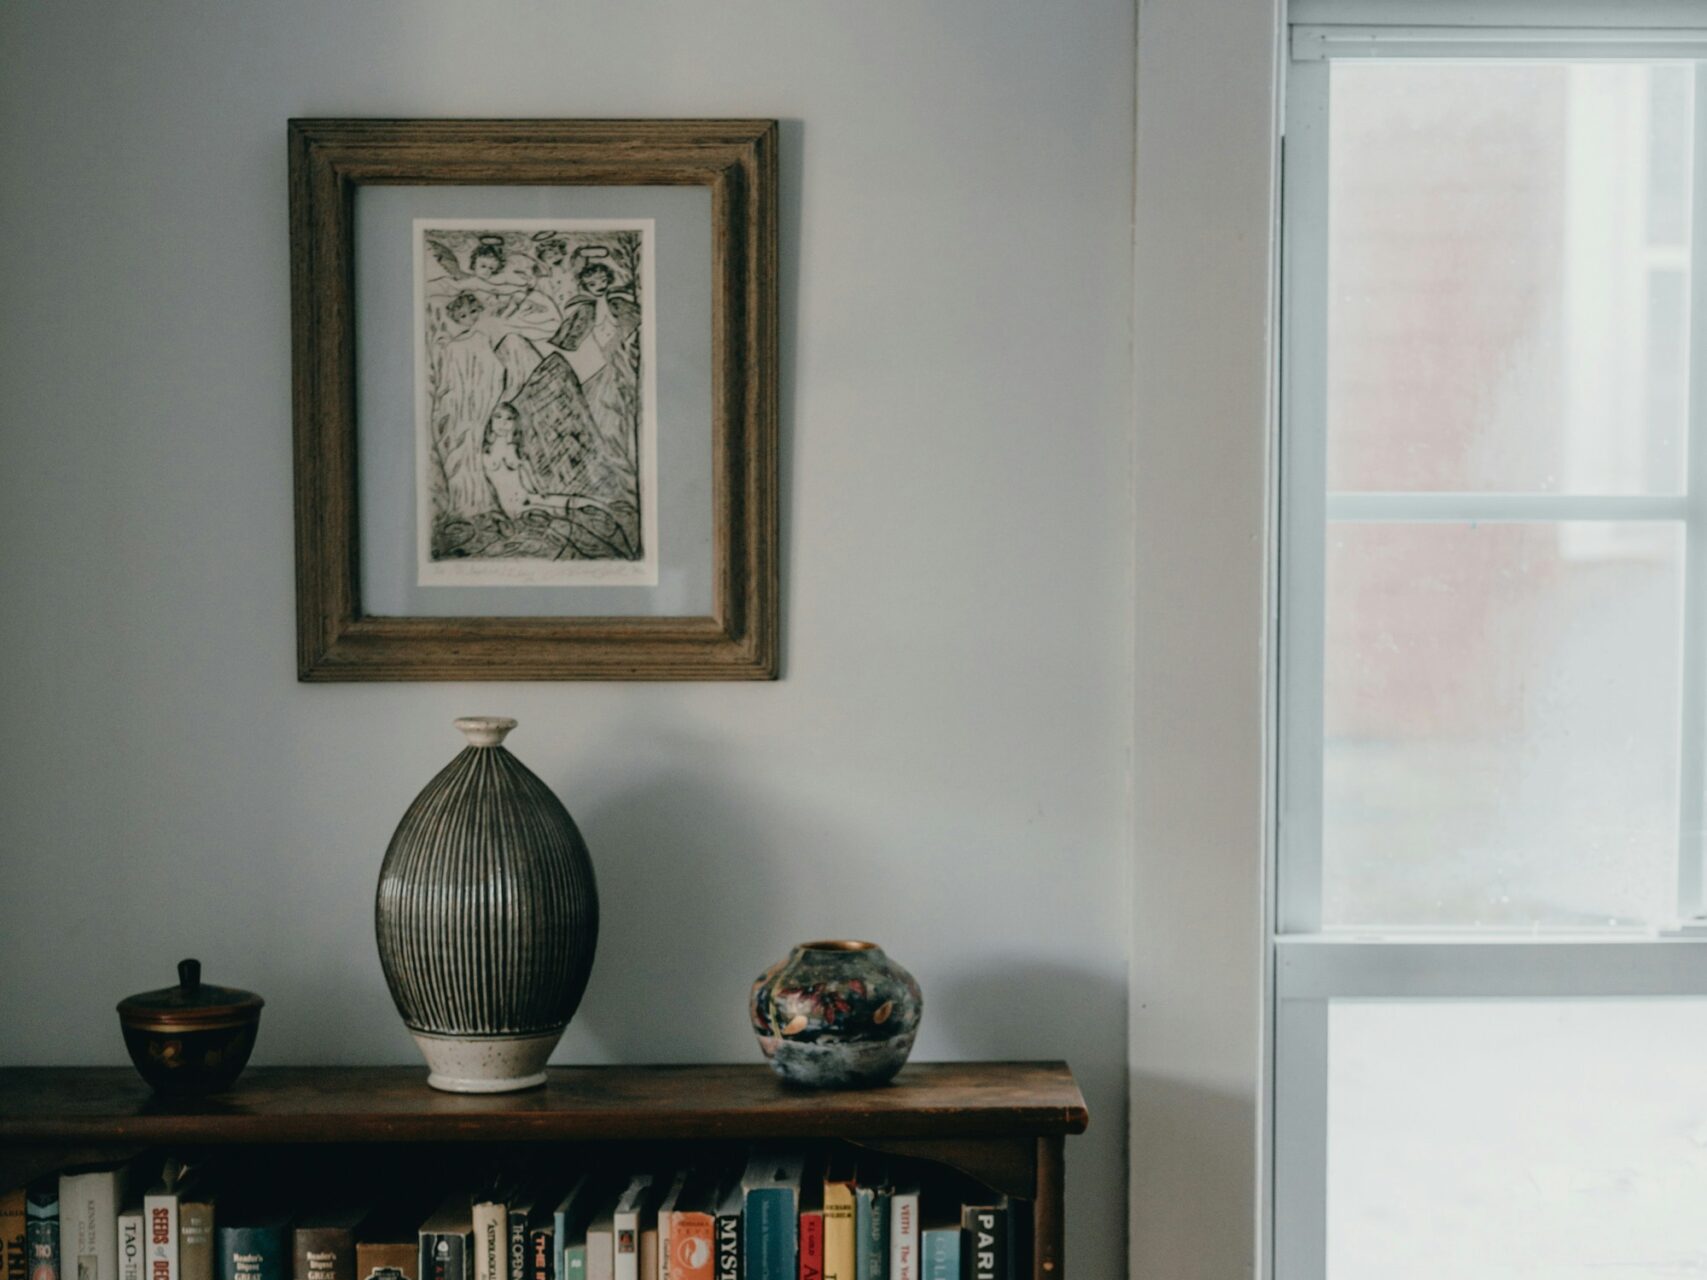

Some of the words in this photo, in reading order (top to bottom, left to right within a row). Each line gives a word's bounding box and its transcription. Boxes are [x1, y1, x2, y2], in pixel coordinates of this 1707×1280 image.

[154, 1207, 169, 1245] SEEDS
[512, 1224, 524, 1244] THE
[306, 1252, 337, 1261] Reader's
[536, 1235, 545, 1268] THE
[901, 1246, 911, 1264] The
[233, 1252, 264, 1262] Reader's
[236, 1263, 260, 1271] Digest
[310, 1261, 333, 1270] Digest
[308, 1271, 336, 1280] GREAT
